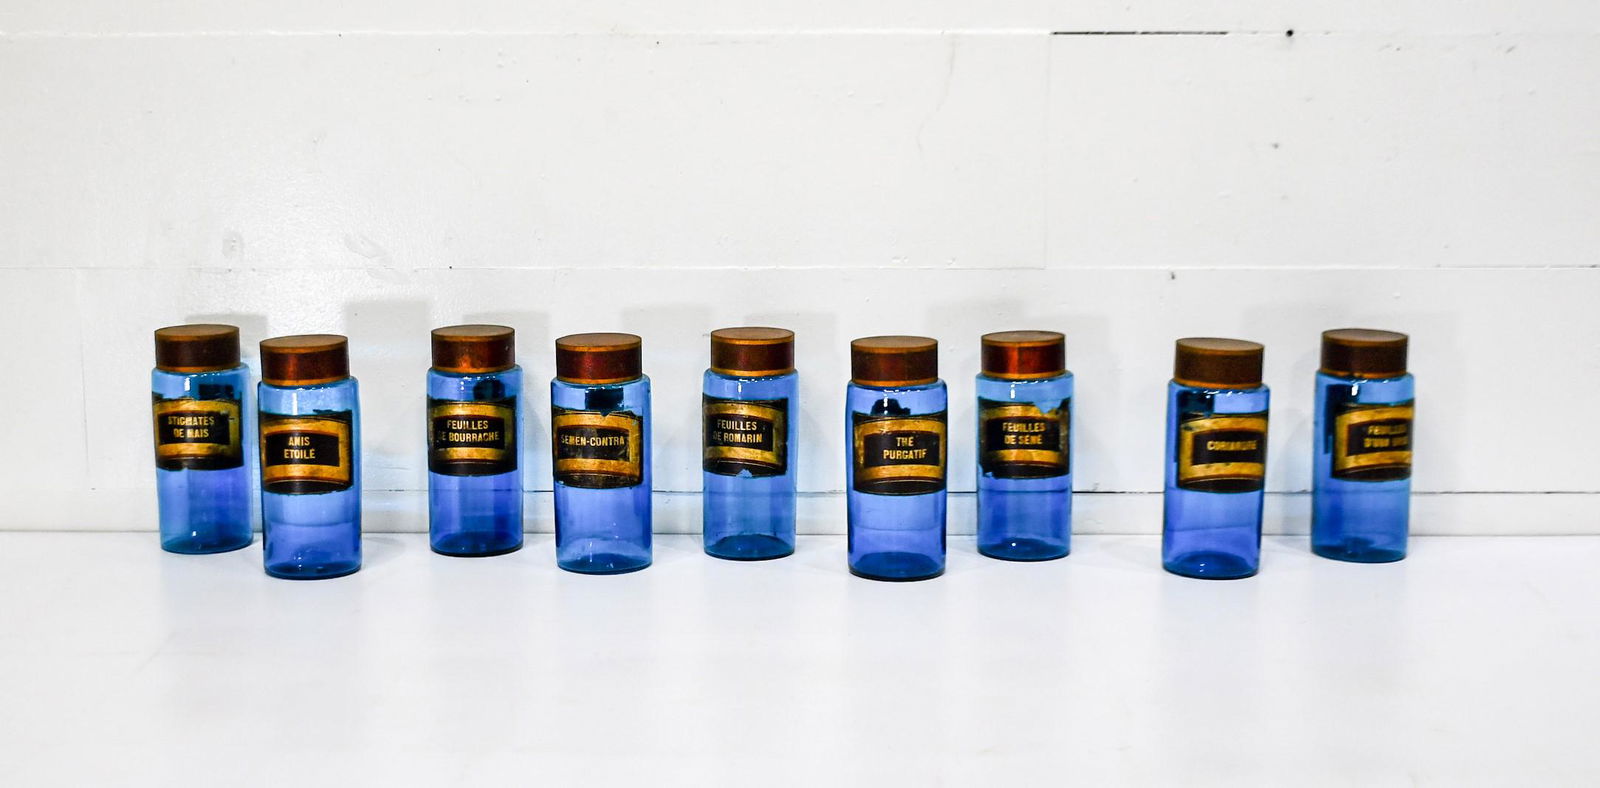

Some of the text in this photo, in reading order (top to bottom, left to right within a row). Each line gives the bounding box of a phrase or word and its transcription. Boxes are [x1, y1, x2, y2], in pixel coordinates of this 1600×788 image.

[167, 416, 216, 426] STIGMATES
[447, 420, 489, 430] FEUILLES
[717, 419, 757, 431] FEUILLES
[1002, 422, 1046, 432] FEUILLES
[173, 428, 185, 438] DE
[449, 431, 500, 442] BOURRACHE
[723, 432, 763, 443] ROMARIN
[288, 436, 310, 446] ANIS
[1004, 435, 1017, 445] DE
[883, 448, 927, 460] PURGATIF
